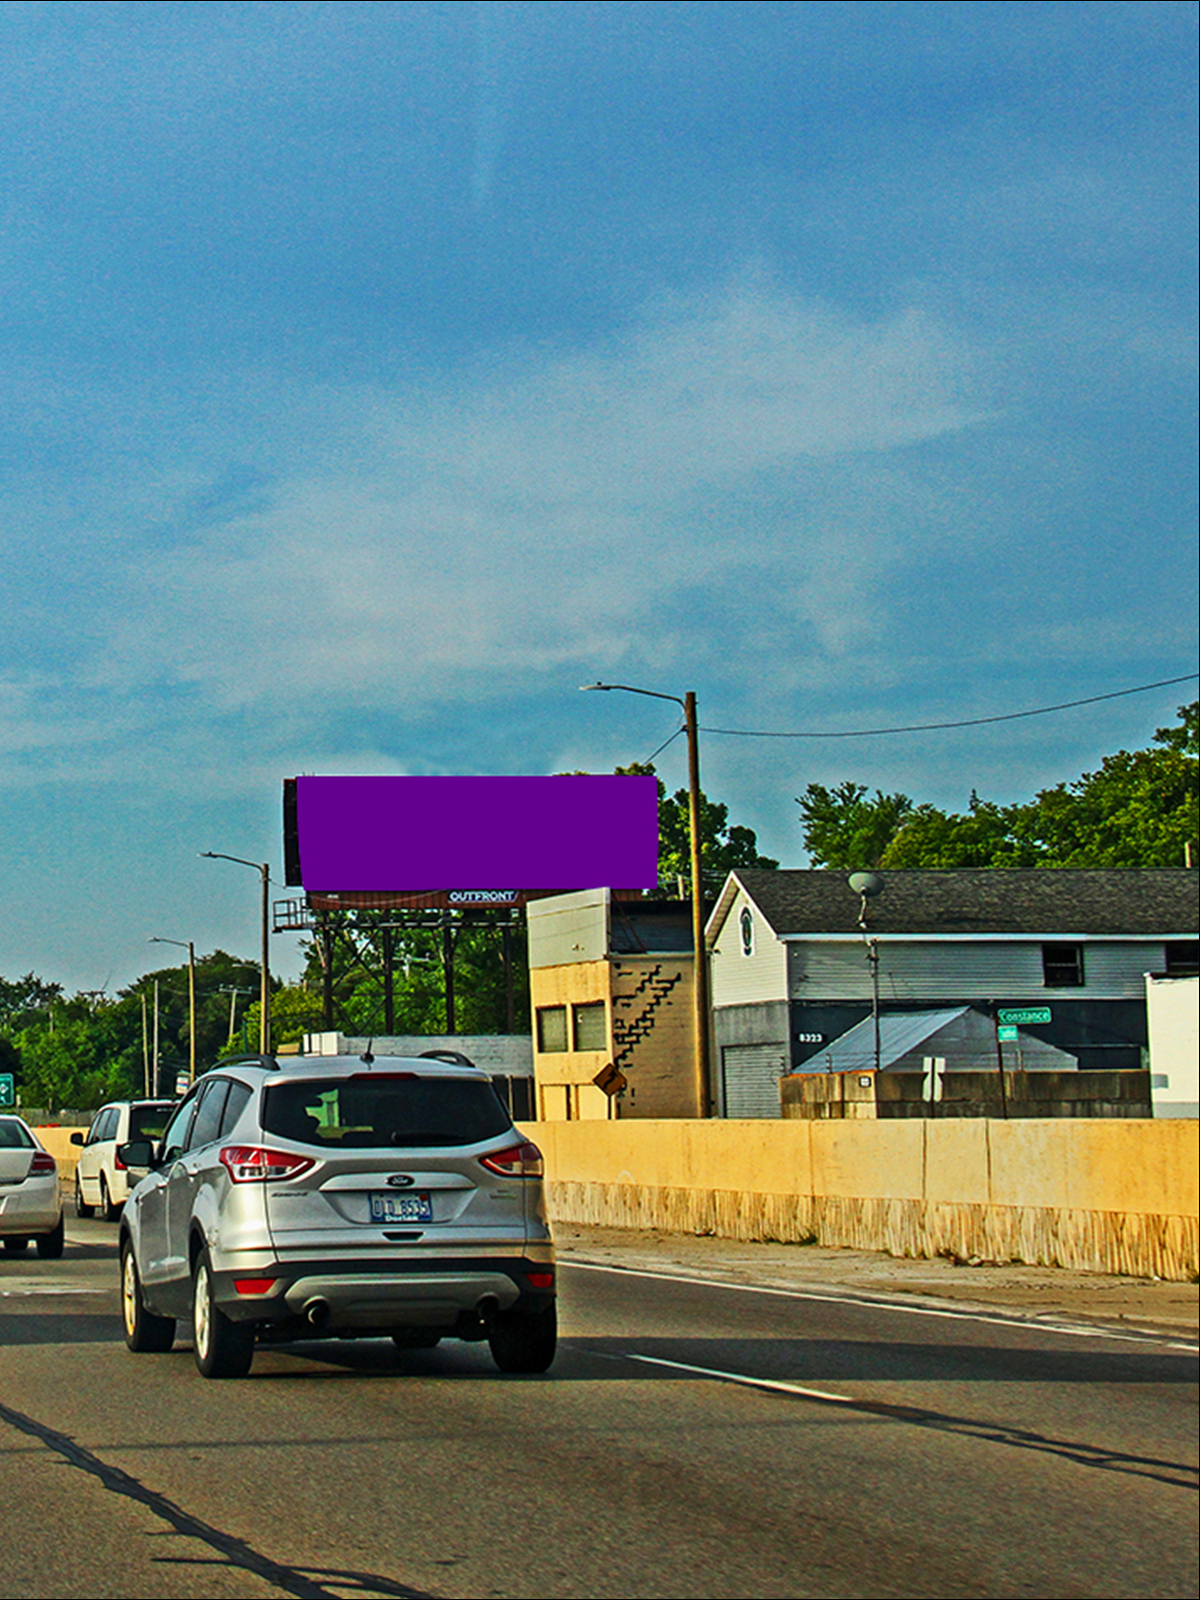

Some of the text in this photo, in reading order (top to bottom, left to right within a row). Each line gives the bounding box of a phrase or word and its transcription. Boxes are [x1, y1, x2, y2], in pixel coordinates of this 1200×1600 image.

[449, 890, 516, 902] OUTFRONT
[1001, 1010, 1049, 1022] Constance
[799, 1033, 823, 1042] 8323
